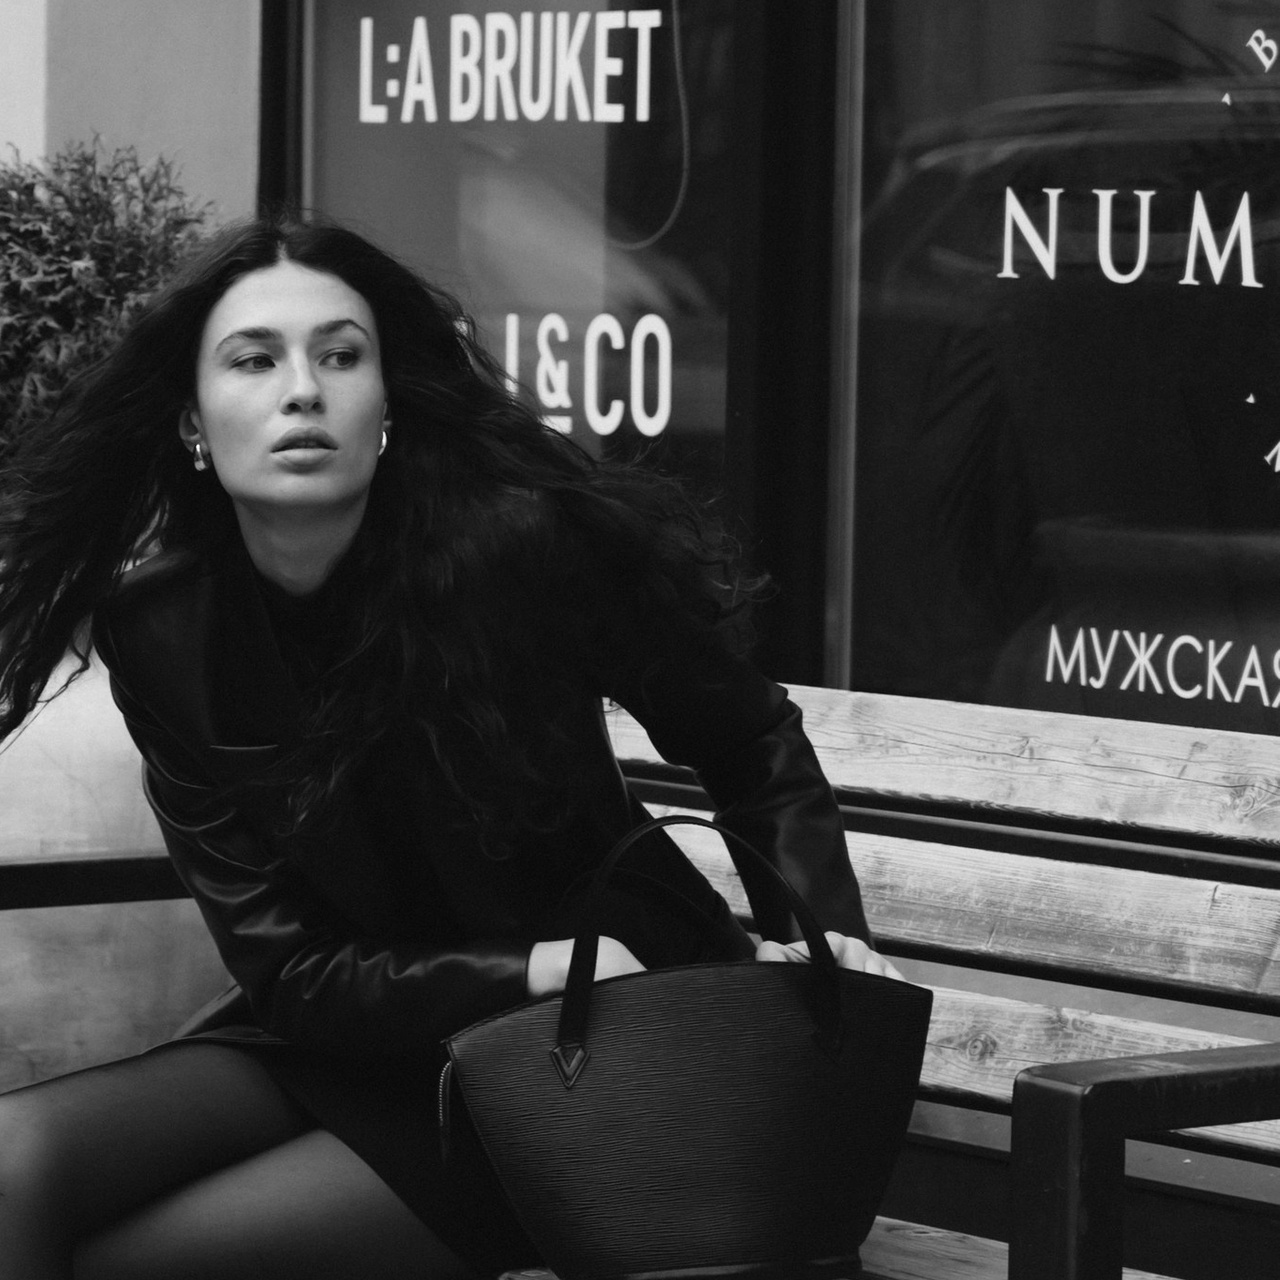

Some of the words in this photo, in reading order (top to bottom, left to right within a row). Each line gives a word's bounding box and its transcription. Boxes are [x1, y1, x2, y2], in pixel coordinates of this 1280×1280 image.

[359, 17, 437, 123] L:A
[449, 10, 662, 123] BRUKET
[996, 186, 1265, 288] NUM
